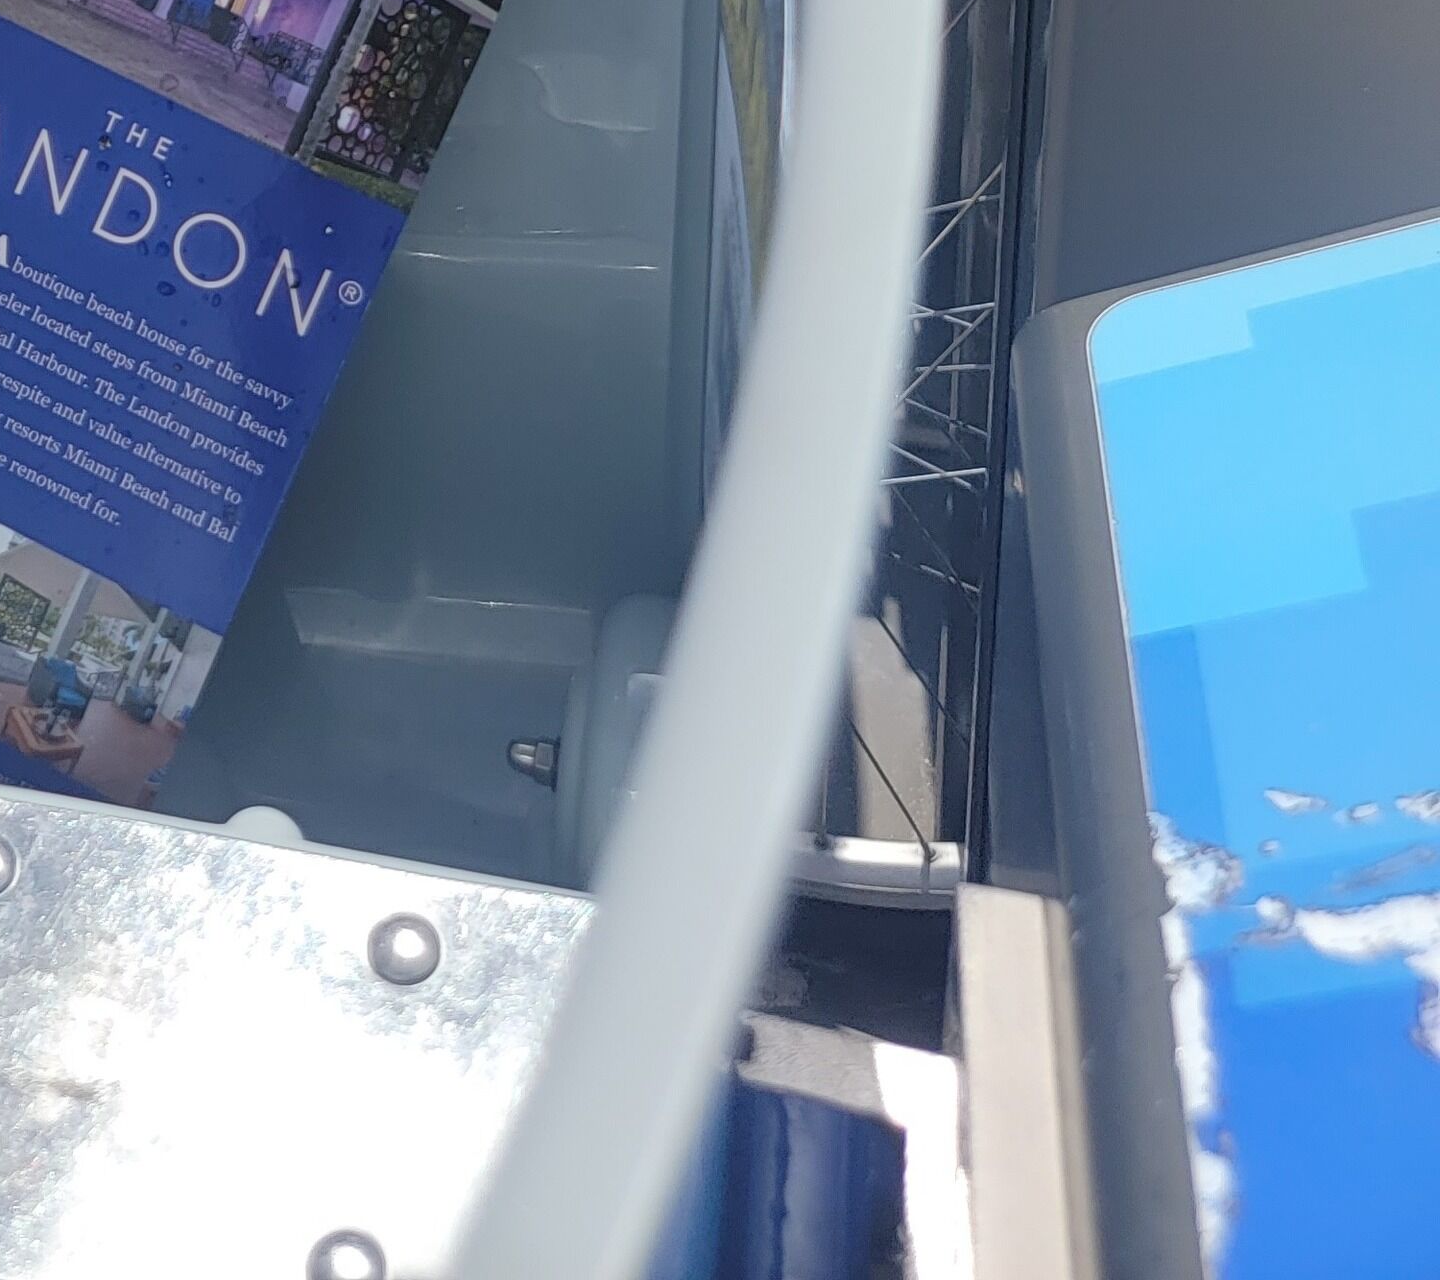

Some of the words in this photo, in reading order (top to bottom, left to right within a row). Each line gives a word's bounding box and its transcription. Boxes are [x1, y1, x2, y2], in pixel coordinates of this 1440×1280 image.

[104, 110, 174, 161] THE
[11, 255, 85, 305] boutique
[85, 292, 134, 331] beach
[136, 318, 187, 356] house
[187, 346, 215, 369] for
[215, 361, 244, 385] the
[244, 378, 293, 410] savvy
[30, 304, 93, 349] located
[91, 341, 136, 371] steps
[136, 360, 178, 393] from
[179, 381, 238, 422] Miami
[237, 410, 288, 448] Beach
[15, 338, 89, 388] Harbour.
[94, 377, 126, 406] The
[126, 395, 191, 440] Landon
[190, 431, 265, 476] provides
[52, 402, 88, 426] and
[89, 418, 132, 450] value
[132, 442, 222, 495] alternative
[223, 486, 243, 505] to
[3, 416, 62, 454] resorts
[62, 443, 119, 483] Miami
[119, 472, 170, 510] Beach
[171, 503, 207, 528] and
[206, 513, 239, 543] Bal
[8, 460, 93, 510] renowned
[92, 499, 121, 526] for.
